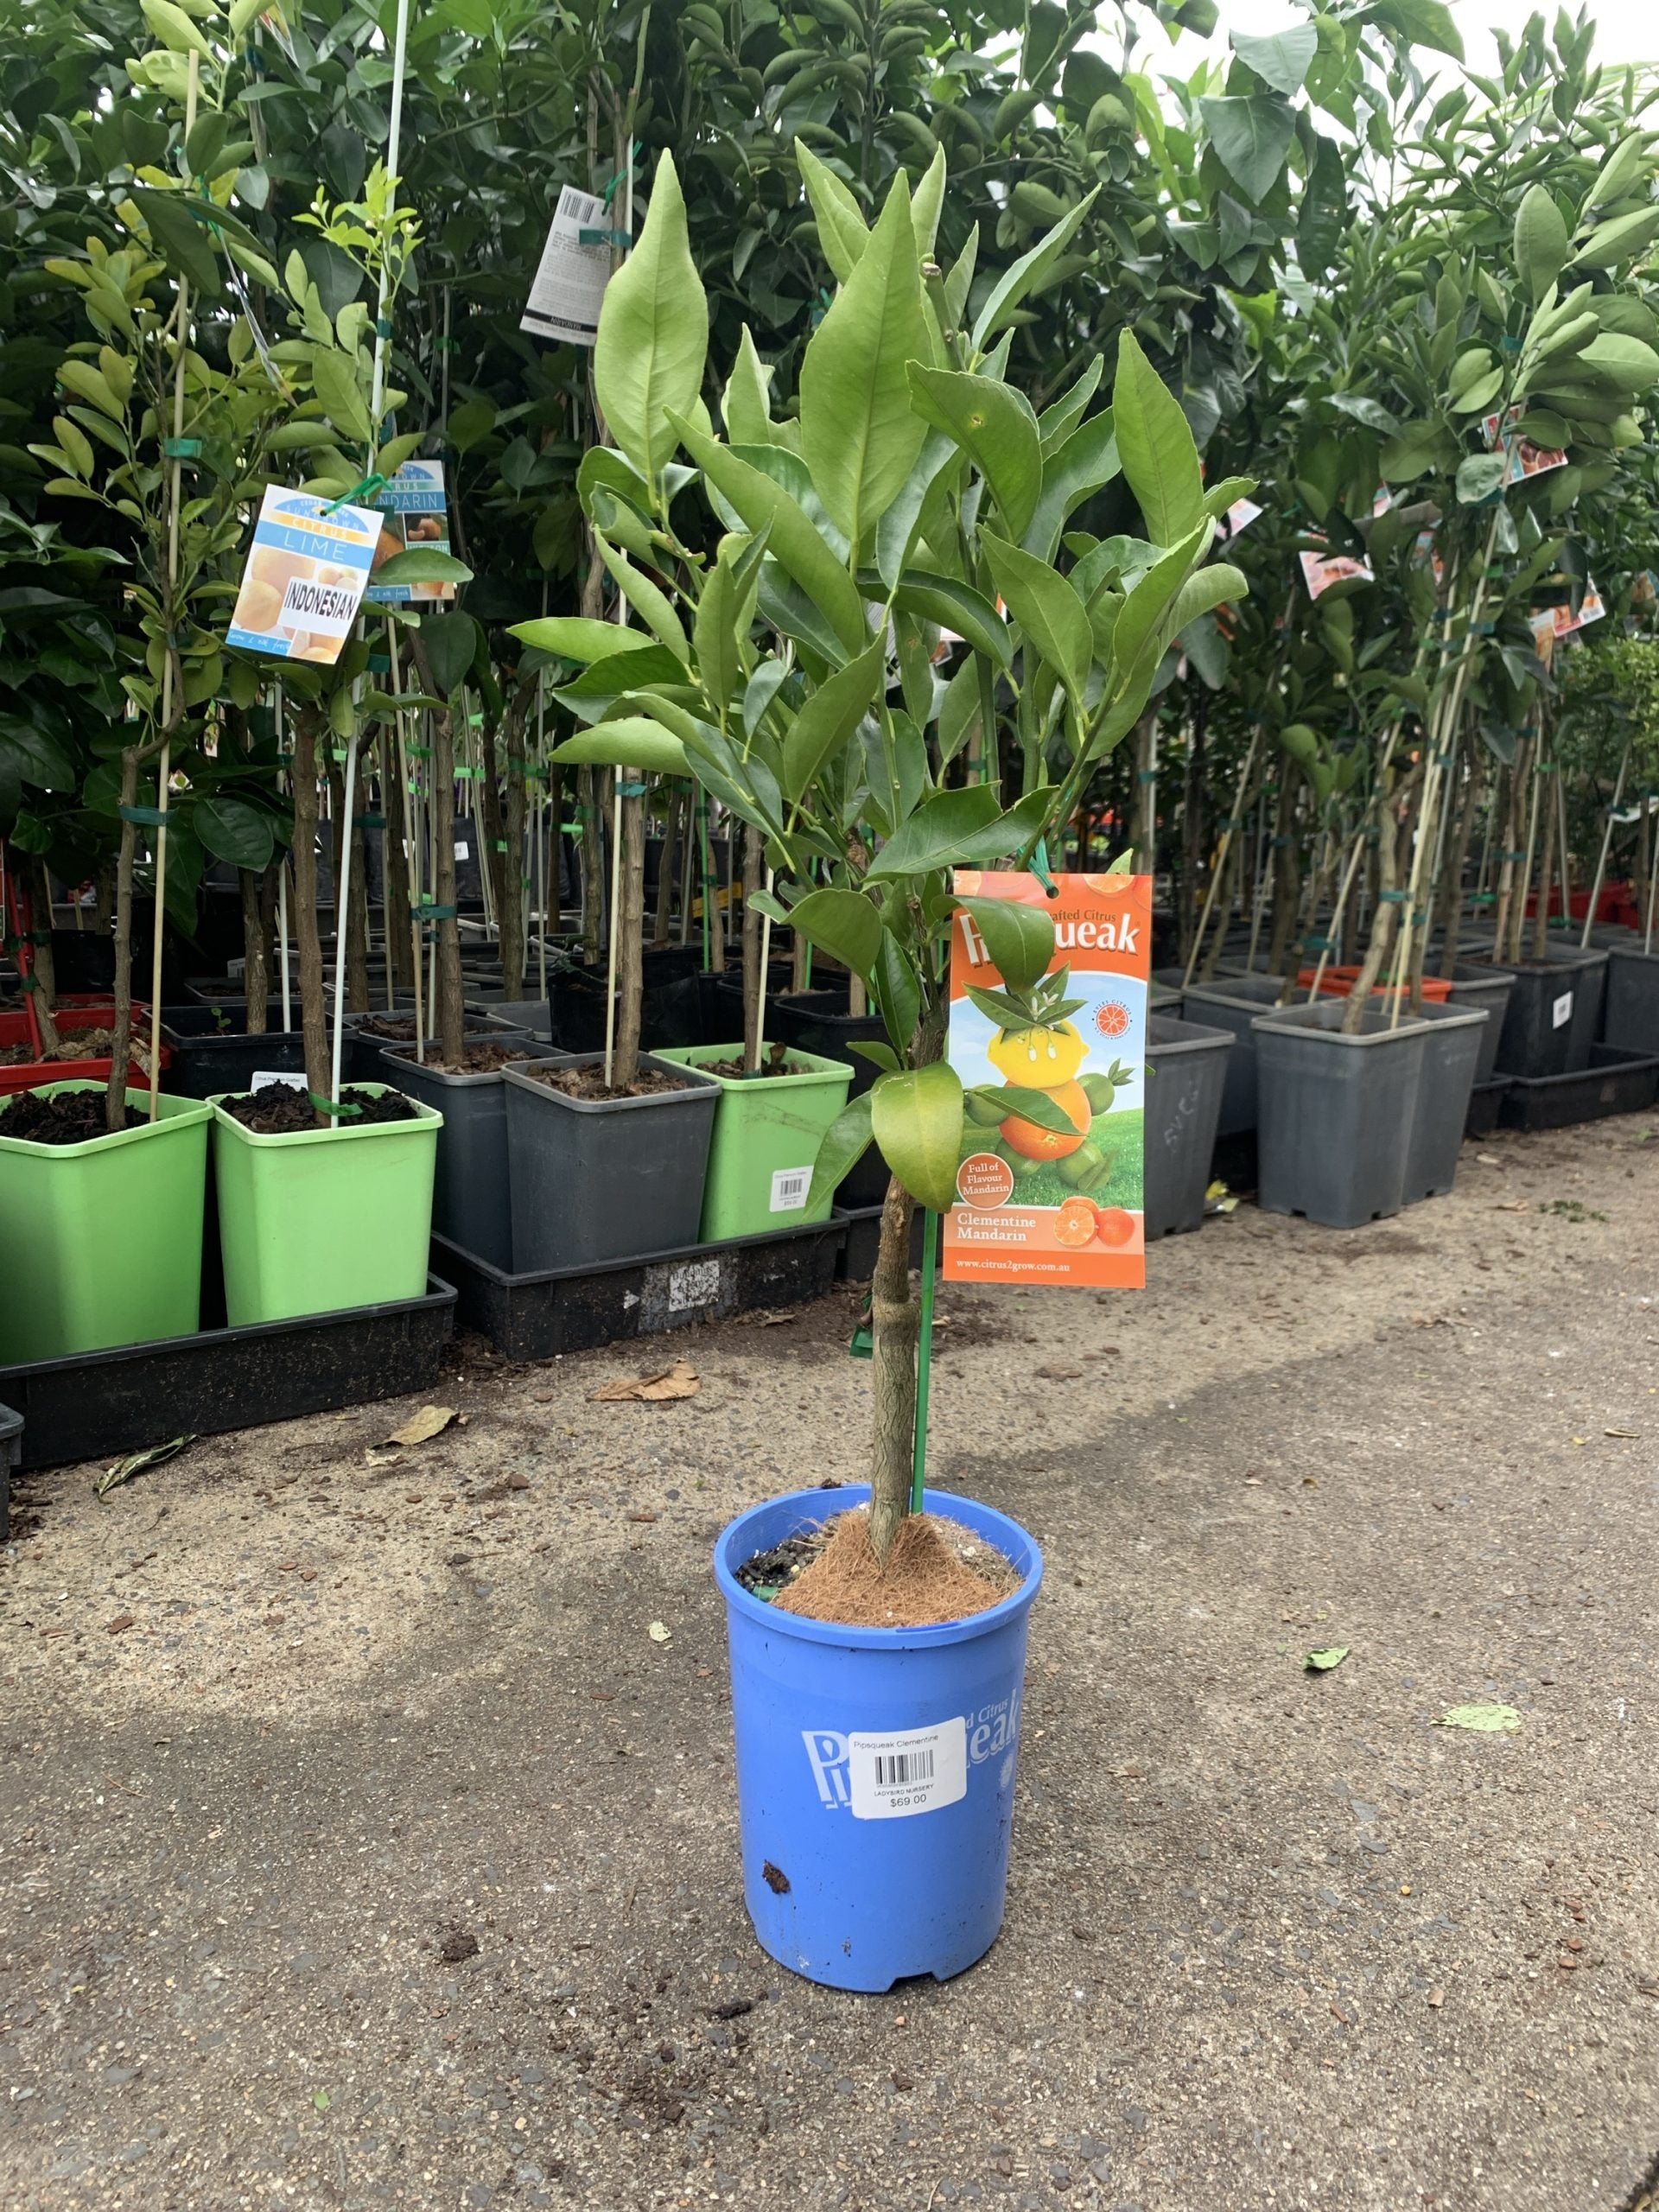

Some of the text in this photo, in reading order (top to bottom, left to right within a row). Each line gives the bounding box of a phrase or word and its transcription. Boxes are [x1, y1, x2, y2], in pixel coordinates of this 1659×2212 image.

[378, 493, 437, 508] NDARIN
[292, 518, 348, 537] CITRUS
[283, 530, 347, 561] LIME
[283, 581, 358, 621] INDONESIAN
[1084, 909, 1116, 922] Citrus
[968, 1162, 999, 1173] Full of
[967, 1174, 1003, 1185] Flavour
[963, 1184, 1009, 1196] Mandarin
[957, 1212, 1036, 1228] Clementine
[957, 1227, 1027, 1242] Mandarin
[956, 1260, 1071, 1273] www.citrus2grow.com.au
[854, 1734, 939, 1750] Pipsqueak Clementine
[906, 1783, 934, 1793] NURSERY
[890, 1794, 927, 1808] $69.00
